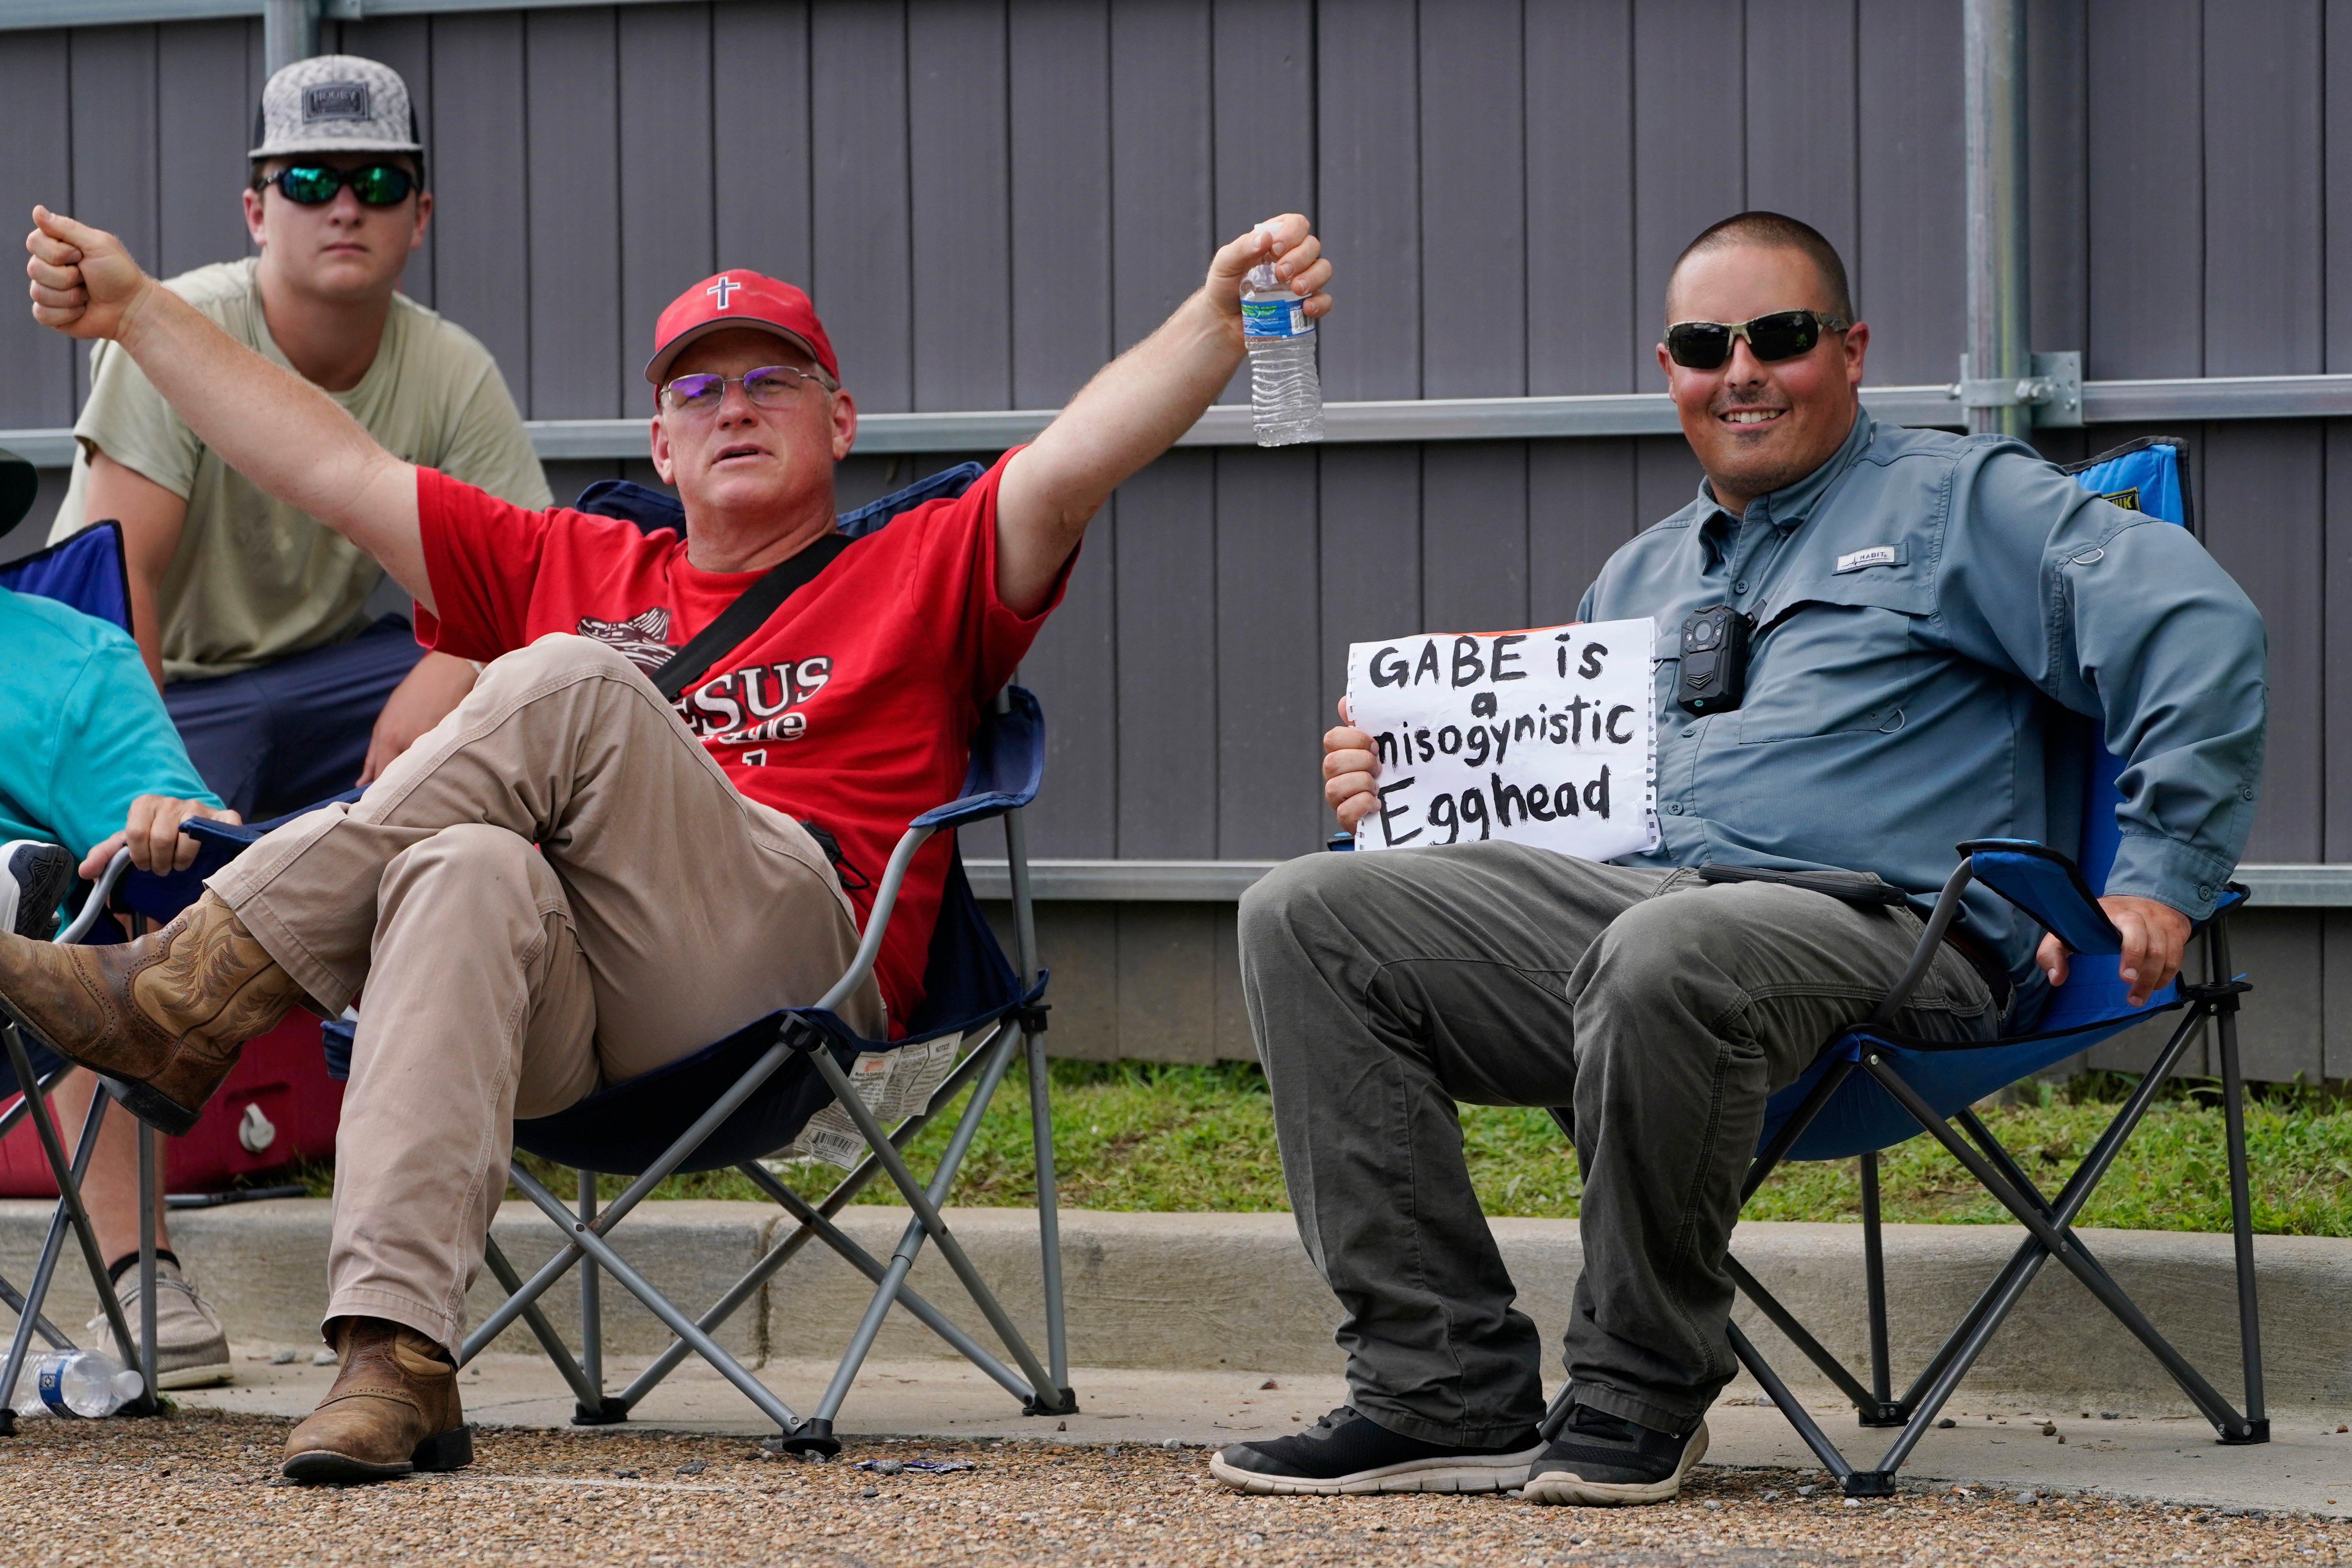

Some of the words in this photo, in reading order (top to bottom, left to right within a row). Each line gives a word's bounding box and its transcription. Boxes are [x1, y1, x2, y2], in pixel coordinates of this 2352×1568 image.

[1370, 635, 1528, 690] GABE
[1555, 632, 1608, 680] is
[1470, 691, 1498, 720] a
[1378, 764, 1611, 847] Egghead
